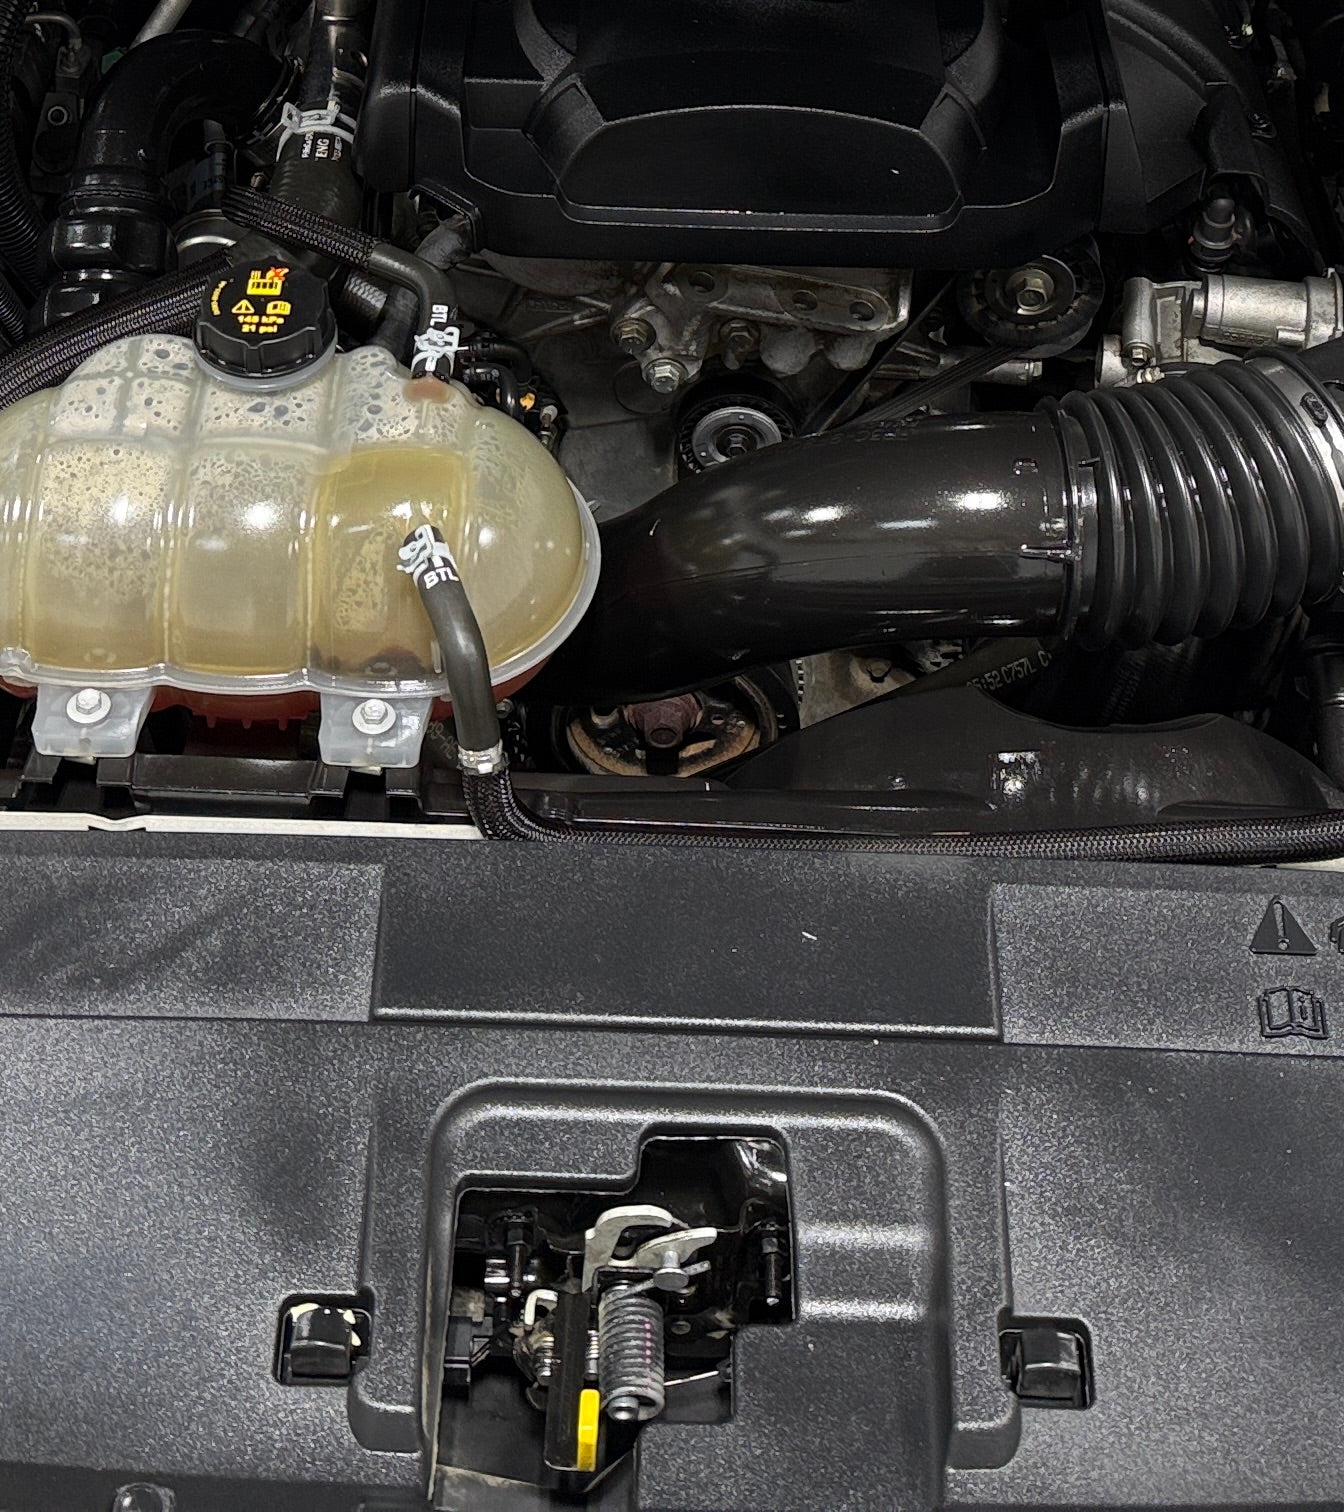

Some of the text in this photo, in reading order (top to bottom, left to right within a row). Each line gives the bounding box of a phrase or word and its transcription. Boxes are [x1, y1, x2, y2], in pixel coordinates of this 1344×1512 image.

[315, 138, 329, 158] ENG
[430, 304, 449, 326] BTL
[259, 325, 278, 334] psi
[423, 567, 459, 590] BTL
